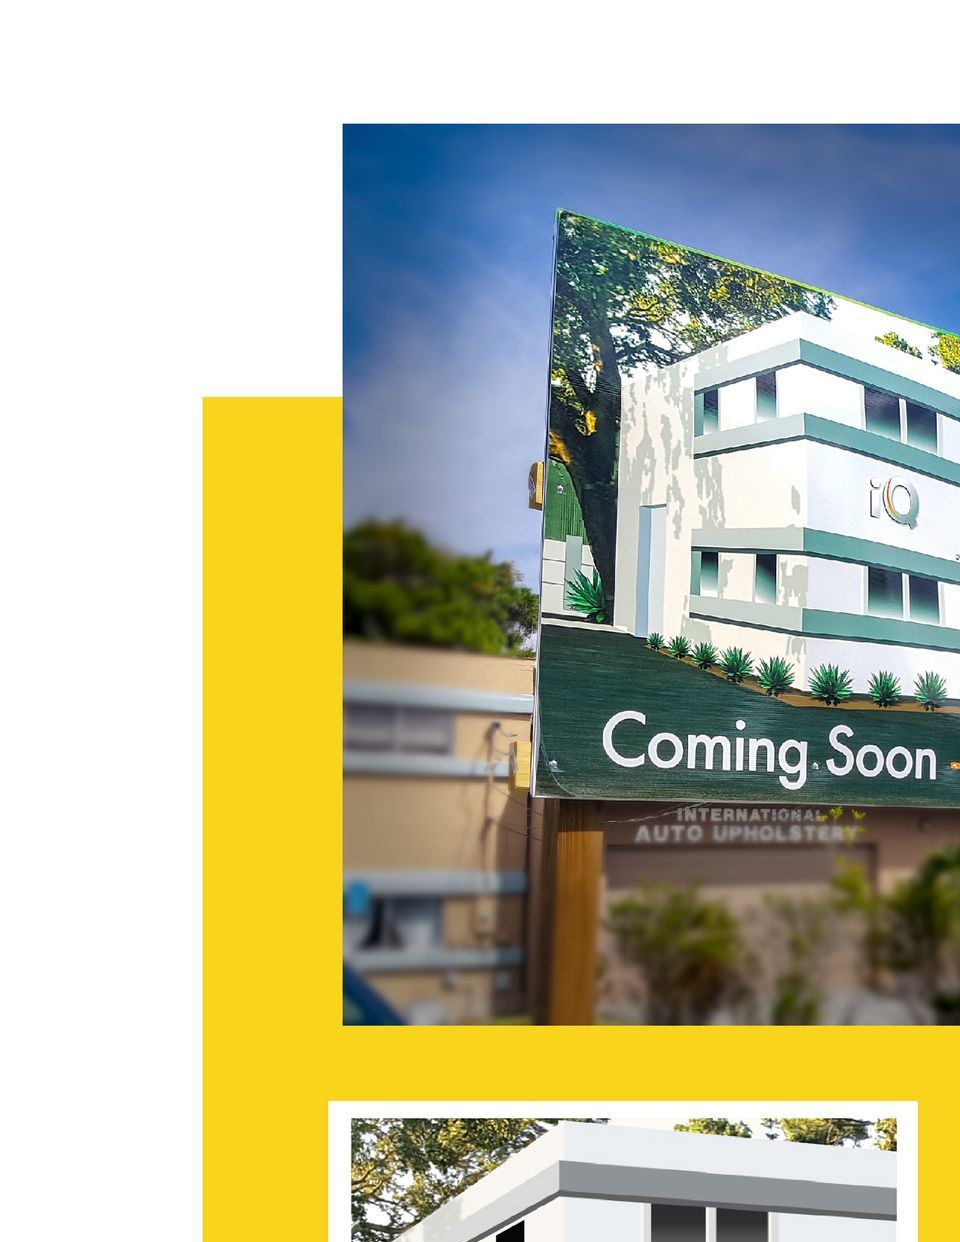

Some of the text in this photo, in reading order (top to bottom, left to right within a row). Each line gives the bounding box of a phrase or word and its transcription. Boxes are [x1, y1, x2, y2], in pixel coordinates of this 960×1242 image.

[602, 710, 808, 790] Coming
[825, 724, 937, 780] Soon
[676, 807, 826, 822] INTERNATIONAL
[634, 825, 858, 843] AUTO UPHOLSTERY
